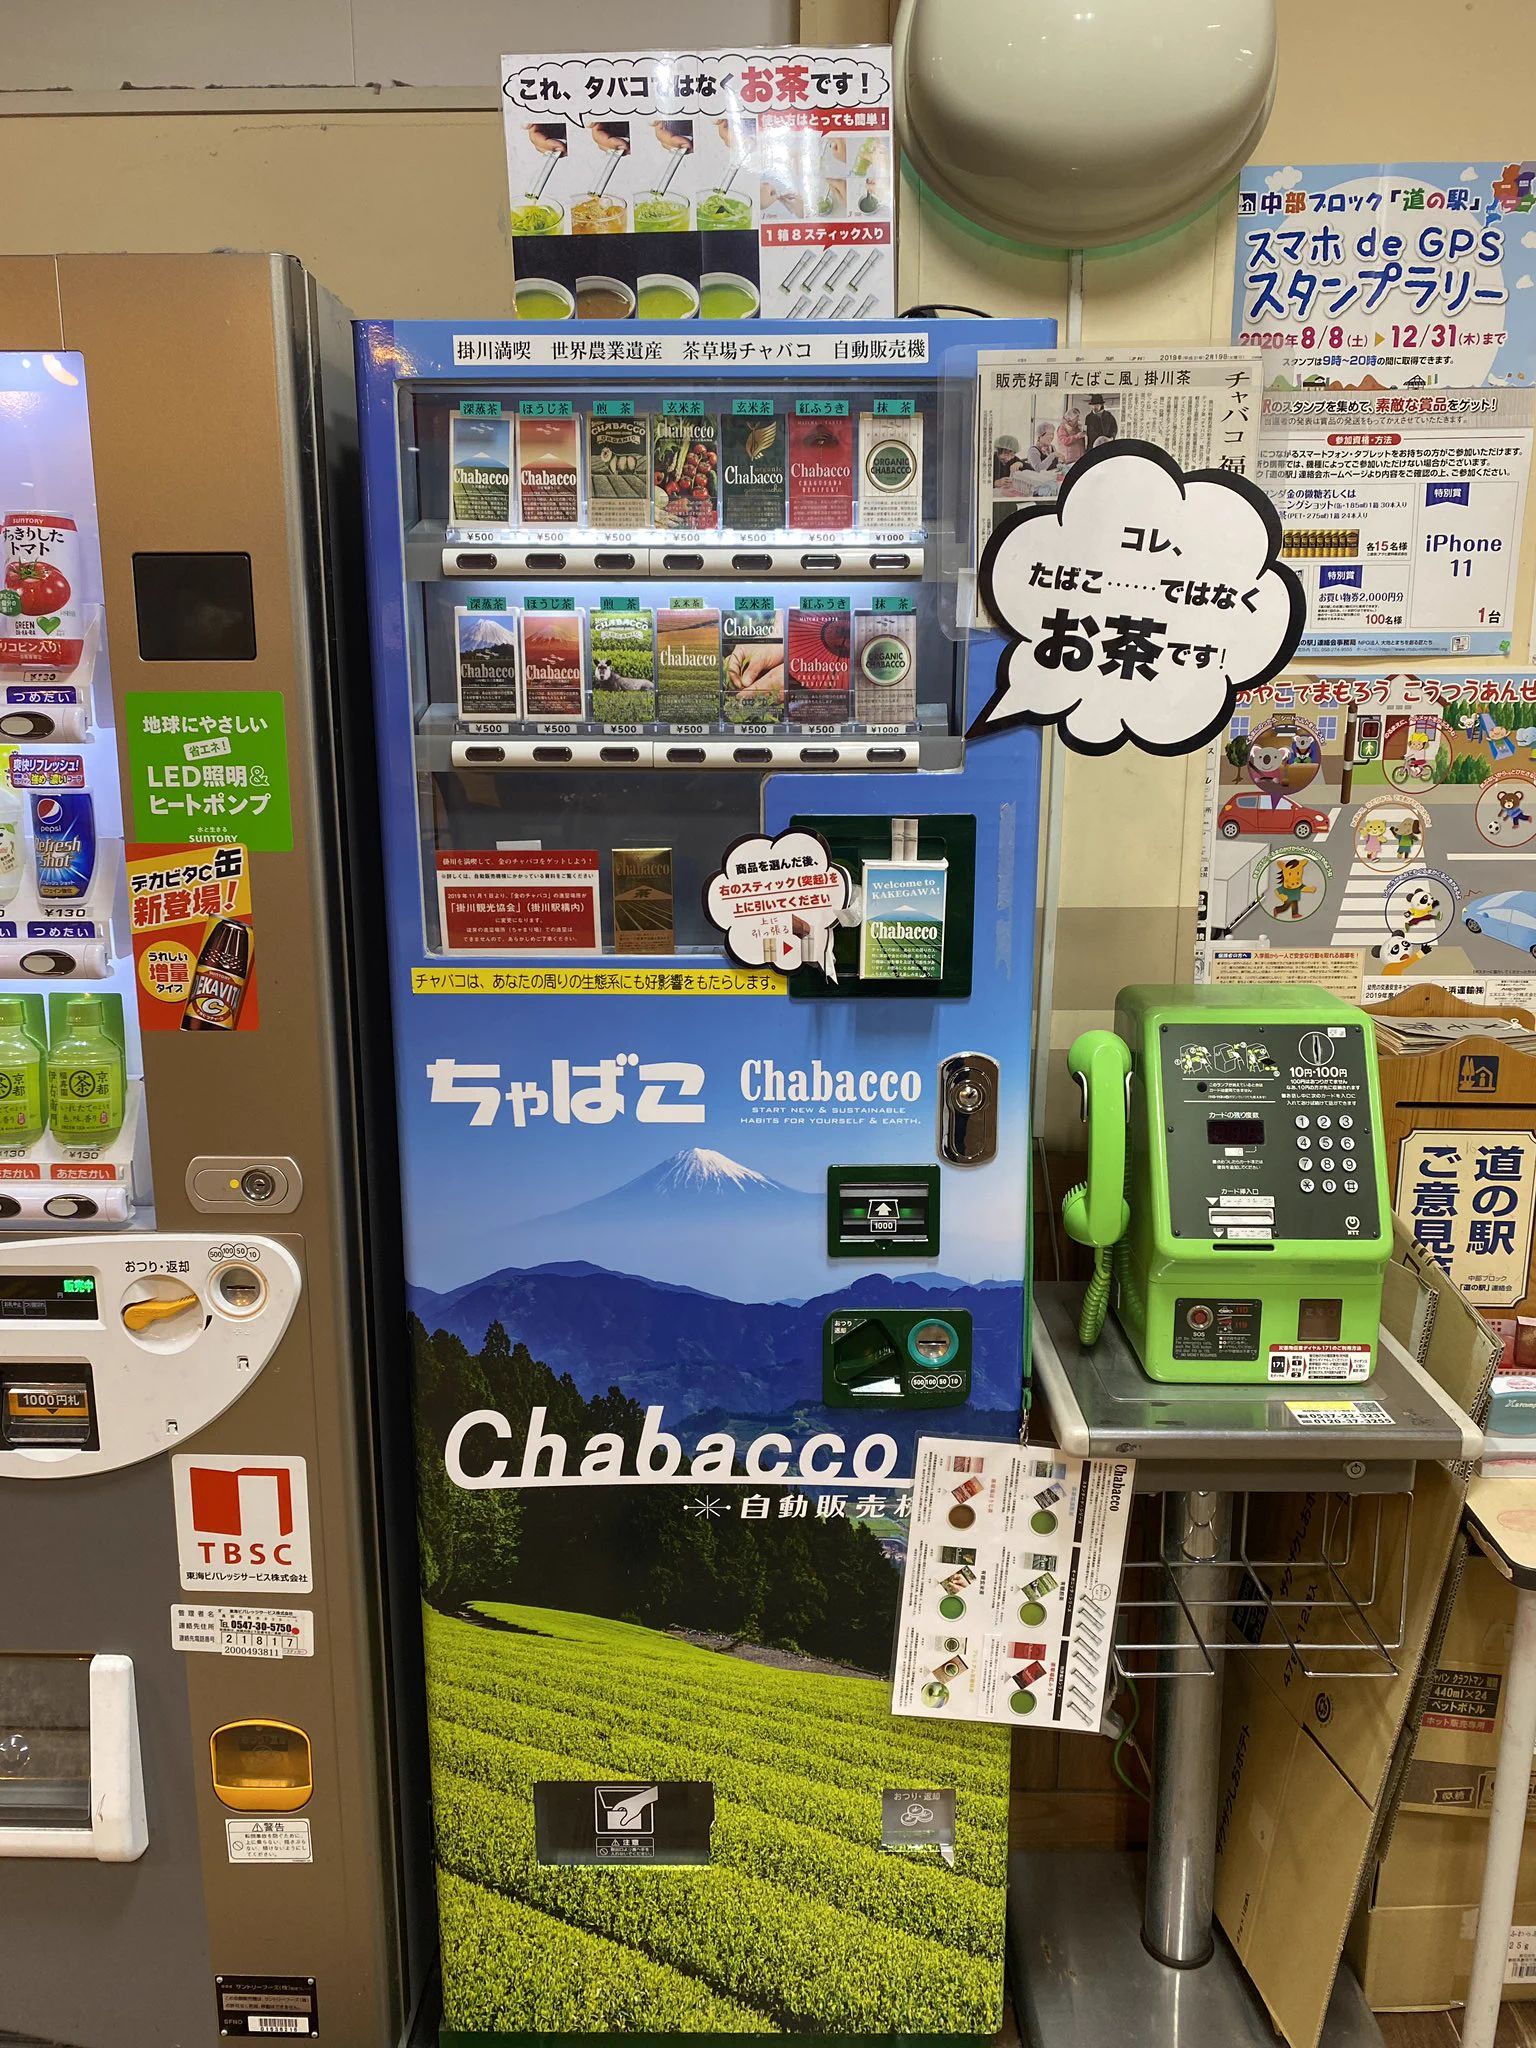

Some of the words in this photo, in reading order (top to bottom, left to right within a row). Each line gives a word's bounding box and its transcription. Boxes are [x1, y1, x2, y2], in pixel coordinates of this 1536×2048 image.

[519, 64, 869, 104] これ、タバコはなくお茶です！
[1260, 188, 1480, 215] 中部ブロック「道の駅」
[1249, 226, 1342, 268] スマホ
[1357, 227, 1403, 257] de
[1419, 227, 1501, 262] GPS
[1248, 263, 1504, 318] スタンプラリー
[456, 340, 532, 361] 掛川満喫
[550, 339, 663, 361] 世界農業遺産
[682, 339, 811, 361] 茶草場チャバコ
[833, 338, 927, 360] 自動販売機
[995, 370, 1191, 389] 販売好調「たばこ風」掛川茶
[462, 403, 498, 415] 深蒸茶
[522, 403, 570, 415] ほうじ茶
[666, 402, 701, 414] 玄米茶
[736, 401, 771, 413] 玄米茶
[799, 402, 846, 415] 紅ふうき
[591, 421, 646, 436] CHABACCO
[656, 417, 714, 440] Chabacco
[872, 457, 911, 466] ORGANIC
[453, 468, 509, 486] Chabacco
[724, 465, 783, 485] Chabacco
[790, 462, 850, 478] Chabacco
[870, 466, 912, 475] CHABACCO
[521, 469, 577, 486] Chabacco
[1434, 488, 1462, 499] 特別賞
[3, 527, 65, 543] すっきりした
[467, 533, 494, 541] ¥500
[673, 533, 700, 541] ¥500
[875, 533, 905, 541] ¥1000
[1120, 526, 1183, 557] コレ、
[10, 542, 51, 556] トマト
[1366, 541, 1408, 551] 各15名様
[1425, 534, 1503, 553] iPhone
[1449, 559, 1472, 577] 11
[1327, 571, 1355, 581] 特別賞
[469, 598, 504, 610] 深蒸茶
[527, 598, 572, 610] ほうじ茶
[673, 600, 700, 608] 玄米茶
[738, 598, 771, 609] 玄米茶
[802, 598, 847, 610] 紅ふうき
[1318, 591, 1404, 603] お買い物券2,000円分
[1365, 614, 1403, 625] 100名様
[1477, 607, 1501, 624] 1台
[15, 621, 35, 630] GREEN
[594, 616, 649, 631] CHABACCO
[1033, 607, 1227, 682] お茶です！
[660, 645, 717, 667] Chabacco
[867, 652, 904, 661] ORGANIC
[461, 663, 515, 679] Chabacco
[790, 658, 848, 673] Chabacco
[866, 660, 906, 669] CHABACCO
[525, 664, 580, 680] Chabacco
[13, 691, 71, 703] つめたい
[142, 715, 269, 734] 地球にやさしい
[475, 725, 502, 733] ¥500
[676, 725, 703, 733] ¥500
[871, 725, 900, 733] ¥1000
[188, 740, 227, 758] 省エネ！
[13, 759, 79, 772] 爽快リフレッシュ！
[147, 765, 271, 788] LED照明&
[150, 792, 272, 816] ヒートポンプ
[40, 825, 62, 833] pepsi
[35, 836, 81, 854] Refresh
[189, 834, 238, 843] SUNTORY
[40, 854, 73, 869] Shot
[615, 861, 670, 876] Chabacco
[735, 855, 819, 876] 商品を選んだ後、
[131, 847, 243, 894] デカビタC缶
[718, 872, 839, 897] 右のスティック(突起)を
[872, 881, 923, 890] Welcome
[872, 887, 941, 900] KAKEGAWA!
[133, 881, 239, 927] 新登場！
[732, 893, 832, 915] 上に引いてください
[44, 908, 86, 917] ¥130
[33, 926, 90, 938] つめたい
[870, 921, 938, 940] Chabacco
[148, 951, 189, 962] うれしい
[150, 963, 190, 983] 増量
[156, 983, 184, 994] タイプ
[415, 972, 778, 992] チャバコは、あなたの周りの生態系にも好影響をもたらします。
[1289, 1066, 1348, 1078] 10円・100円
[96, 1071, 109, 1095] 京都
[425, 1053, 706, 1128] ちゃばこ
[740, 1058, 923, 1102] Chabacco
[751, 1106, 786, 1114] START
[789, 1106, 816, 1114] NEW
[831, 1105, 907, 1114] SUSTAINABLE
[1208, 1111, 1260, 1119] カードの残り度数
[740, 1117, 780, 1125] HABITS
[783, 1117, 806, 1125] FOR
[808, 1116, 866, 1125] YOURSELF
[880, 1116, 922, 1125] EARTH.
[69, 1151, 99, 1160] ¥130
[56, 1168, 110, 1180] あたたかい
[1465, 1145, 1525, 1256] 道の駅
[873, 1221, 894, 1230] 1000
[124, 1260, 190, 1274] おつり・返却
[63, 1279, 94, 1294] 販売中
[1459, 1283, 1513, 1292] 「道の駅」連絡会
[1235, 1306, 1248, 1314] 110
[23, 1394, 80, 1407] 1000円札
[444, 1404, 908, 1490] Chabacco
[1109, 1463, 1128, 1512] Chabacco
[197, 1541, 293, 1566] TBSC
[186, 1571, 309, 1584] 東海ビバレッジサービス株式会社
[177, 1609, 215, 1619] 管理者名
[178, 1622, 215, 1631] 連絡先住所
[219, 1619, 230, 1629] TEL
[231, 1619, 292, 1633] 0547-30-5750
[1434, 1686, 1488, 1701] 440ml×24
[1431, 1700, 1486, 1714] ペットボトル
[1426, 1716, 1487, 1731] ホット販売専用
[893, 1791, 941, 1801] おつり・返却
[263, 1822, 285, 1832] 警告
